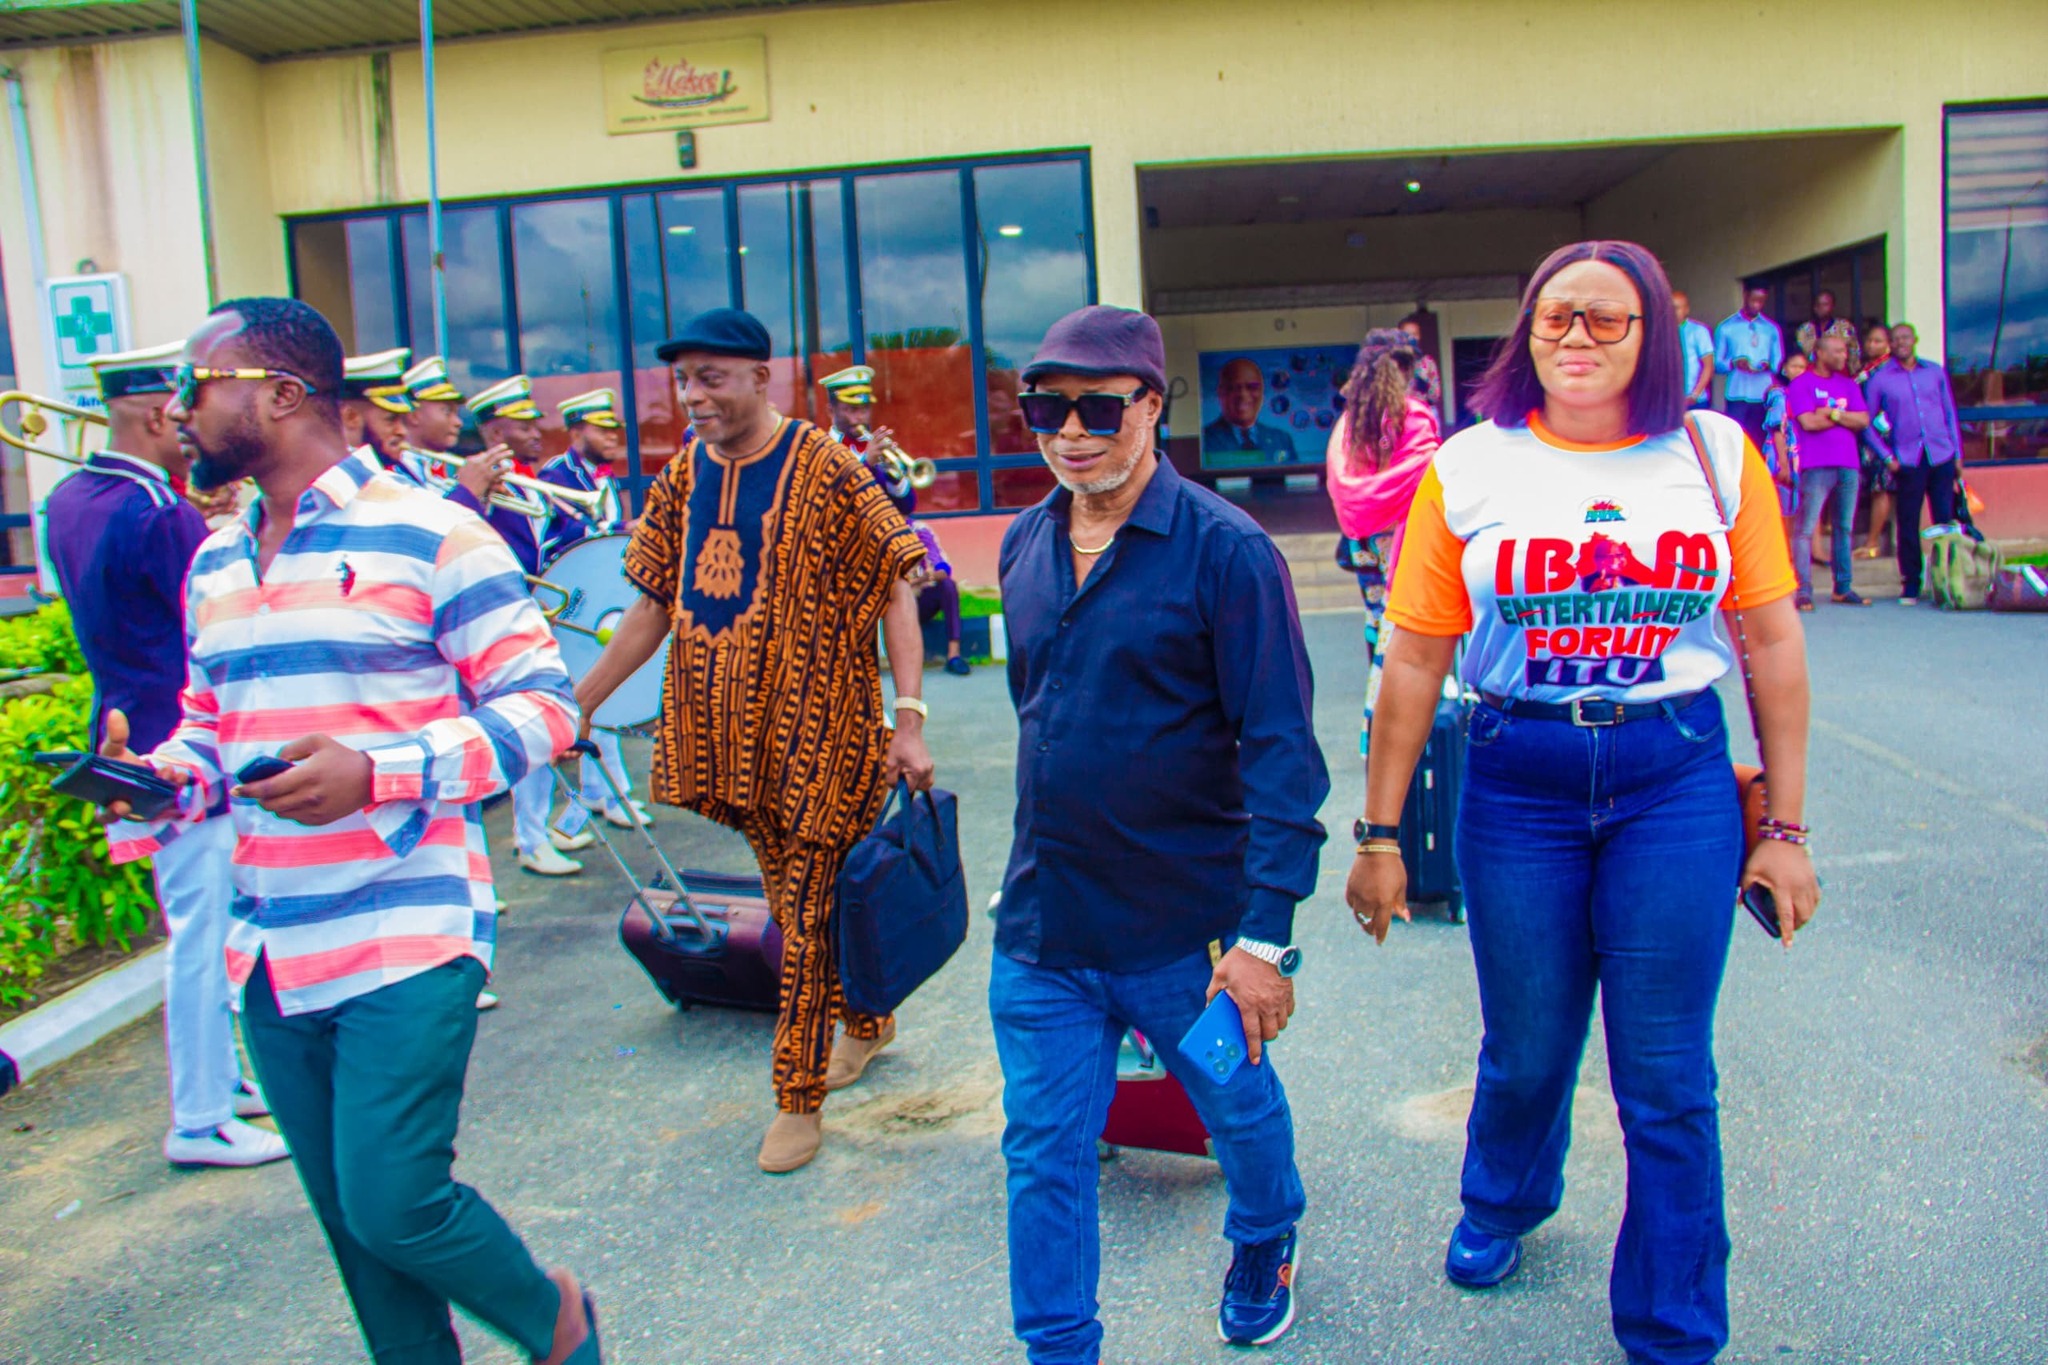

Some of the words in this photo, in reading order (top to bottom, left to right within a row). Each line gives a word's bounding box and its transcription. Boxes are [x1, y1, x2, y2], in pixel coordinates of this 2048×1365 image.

[1495, 531, 1718, 595] IBM
[1495, 591, 1716, 627] ENTERTAINERS
[1524, 626, 1681, 659] FORUM
[1546, 657, 1650, 684] ITU
